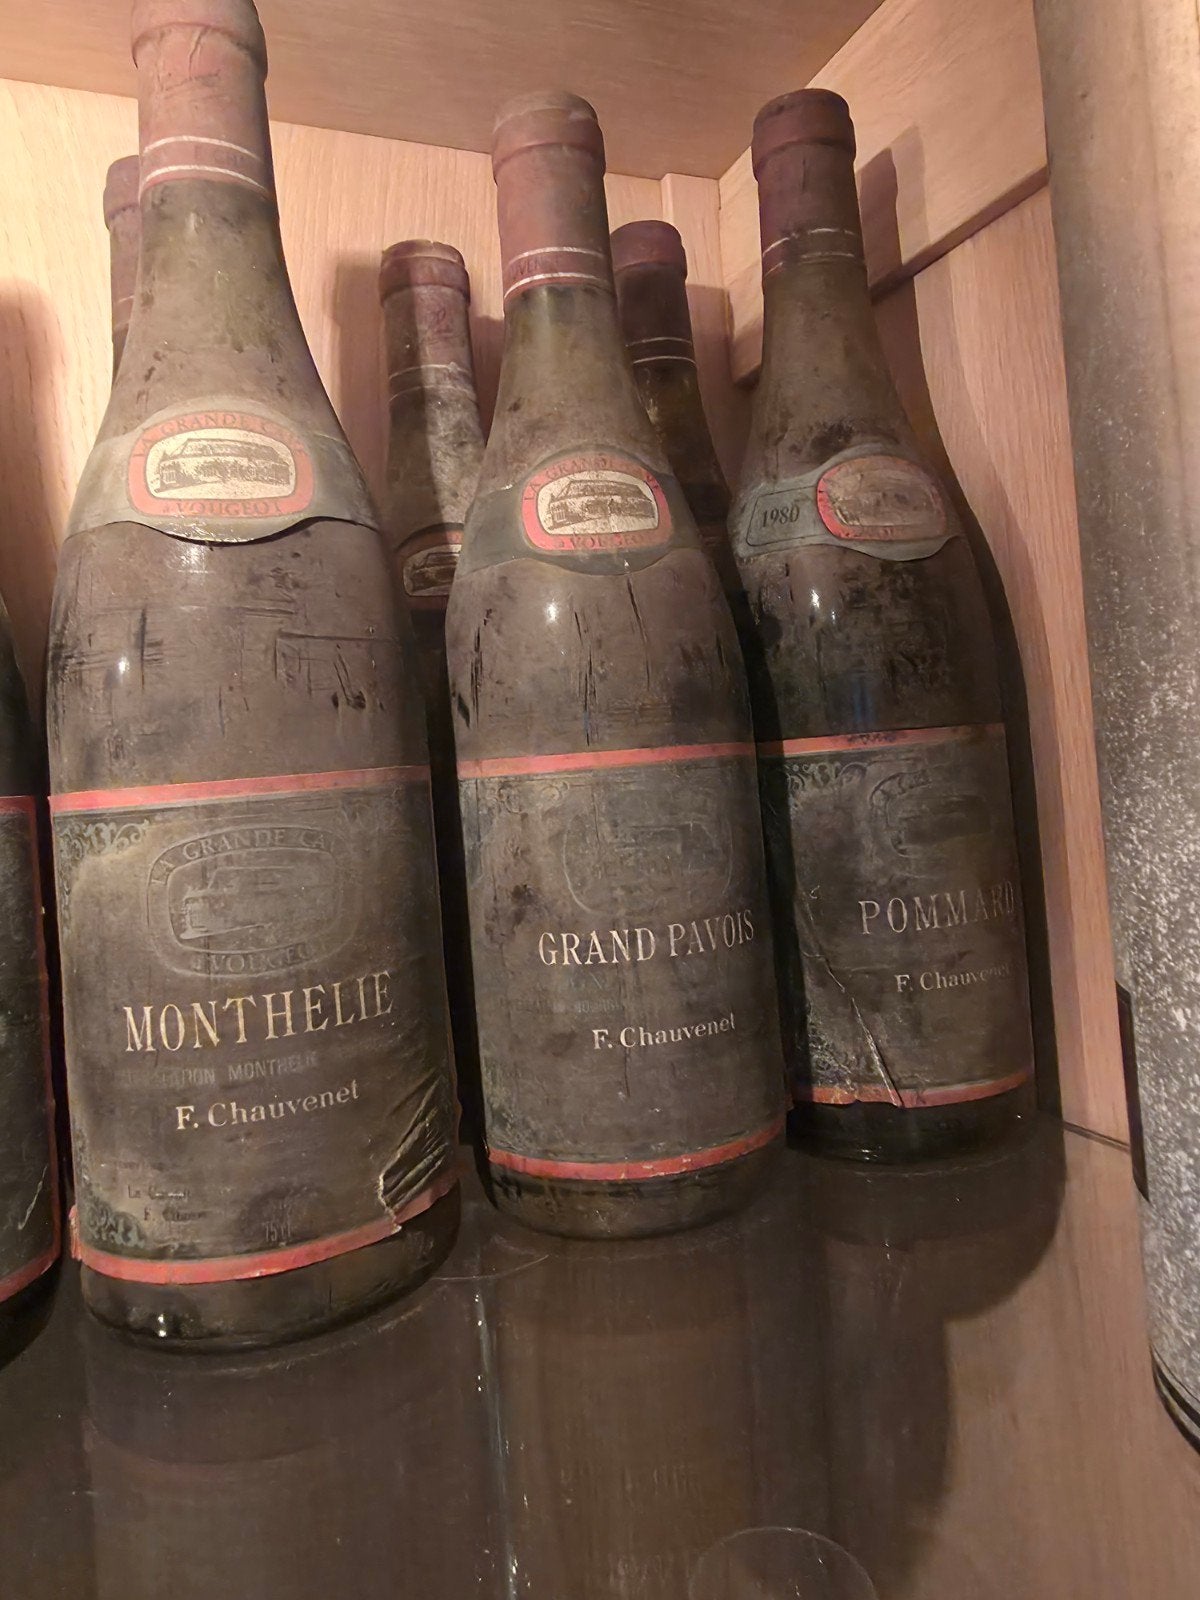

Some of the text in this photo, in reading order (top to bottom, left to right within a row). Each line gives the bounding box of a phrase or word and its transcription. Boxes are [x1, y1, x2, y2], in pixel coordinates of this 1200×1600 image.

[546, 453, 616, 478] GRAND
[761, 503, 801, 527] 1980
[183, 829, 286, 860] GRANDE
[858, 880, 1015, 936] POMMARD
[538, 908, 755, 967] GRAND PAVOIS
[211, 941, 322, 974] VOUGEO
[893, 973, 914, 994] F.
[123, 970, 394, 1053] MONTHELIE
[591, 1010, 737, 1051] F. Chauvenet
[175, 1078, 361, 1131] F. Chauvenet
